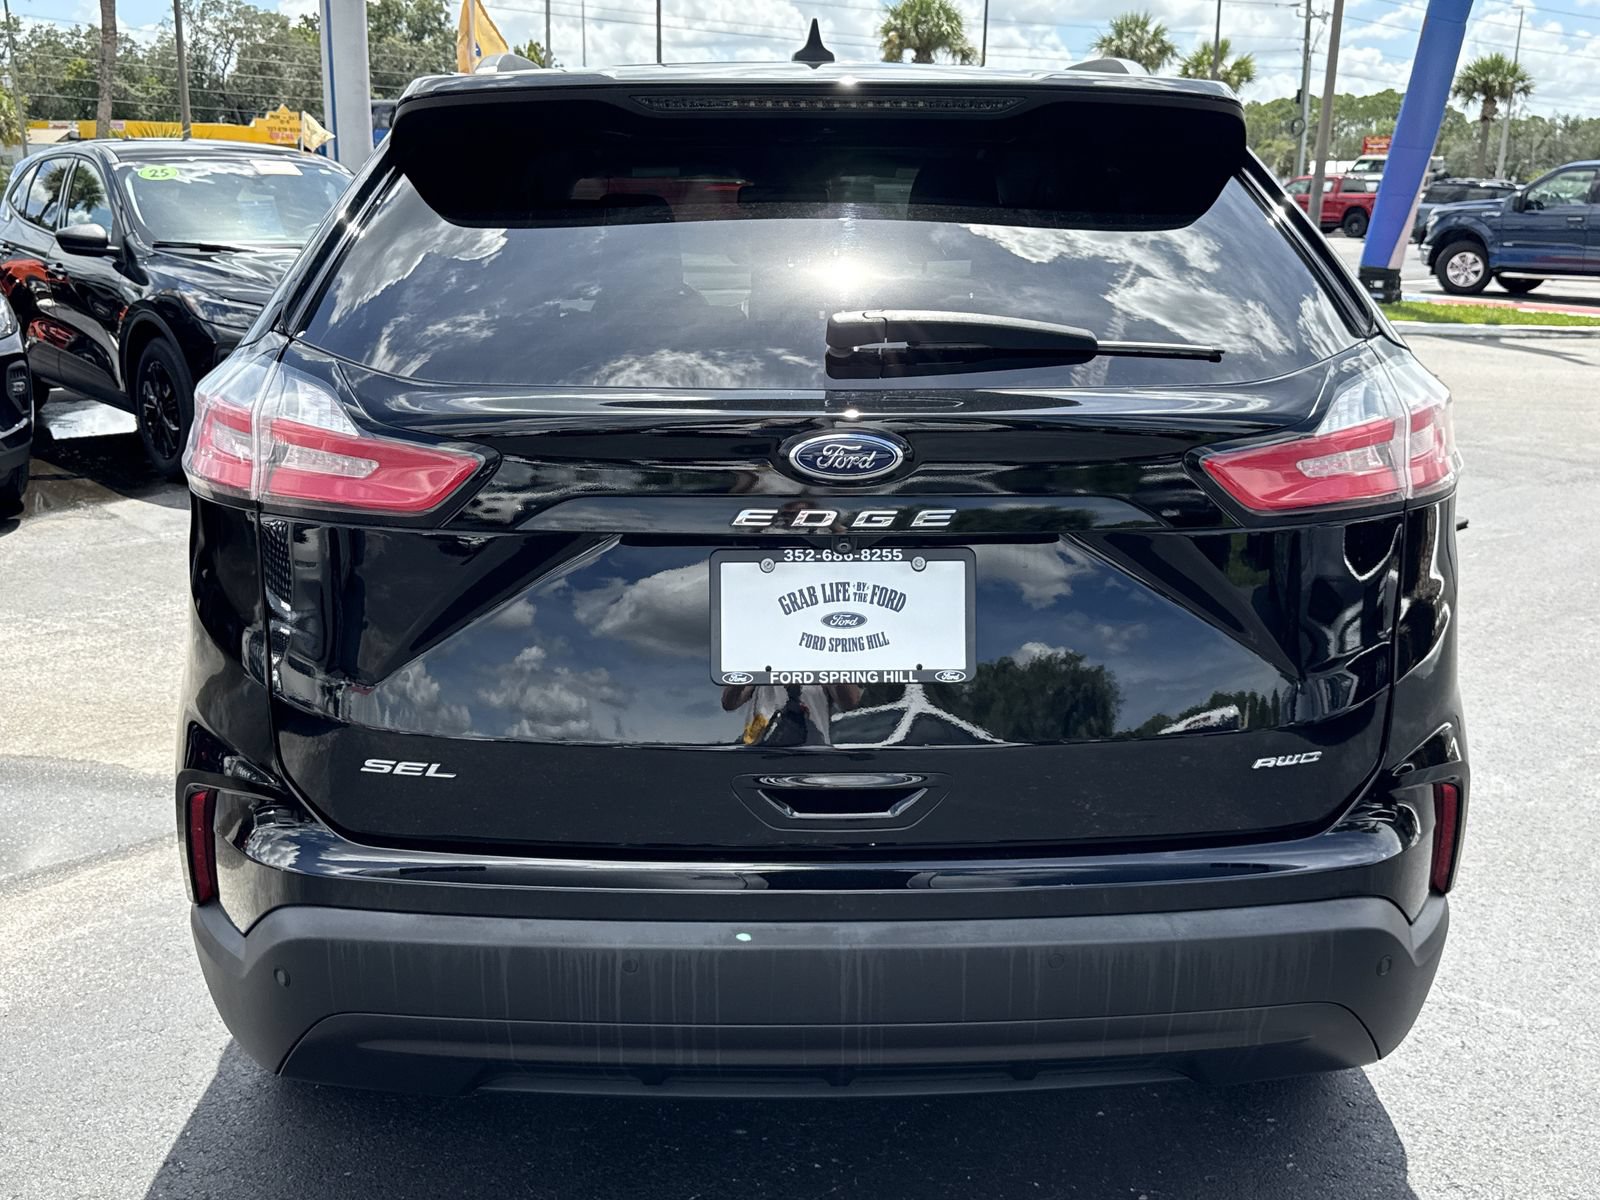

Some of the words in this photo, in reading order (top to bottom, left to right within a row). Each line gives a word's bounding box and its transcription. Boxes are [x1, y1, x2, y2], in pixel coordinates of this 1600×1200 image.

[732, 509, 957, 528] EDGE
[821, 581, 851, 604] LIFE
[856, 581, 867, 592] BY
[778, 585, 819, 616] GRAB
[853, 592, 868, 602] THE
[869, 584, 907, 613] FORD
[799, 632, 827, 652] FORD
[828, 636, 866, 653] SPRING
[866, 631, 890, 650] HILL
[770, 672, 814, 684] FORD
[818, 671, 880, 684] SPRING
[883, 671, 918, 683] HILL
[360, 759, 457, 778] SEL
[1252, 751, 1322, 769] AWD
